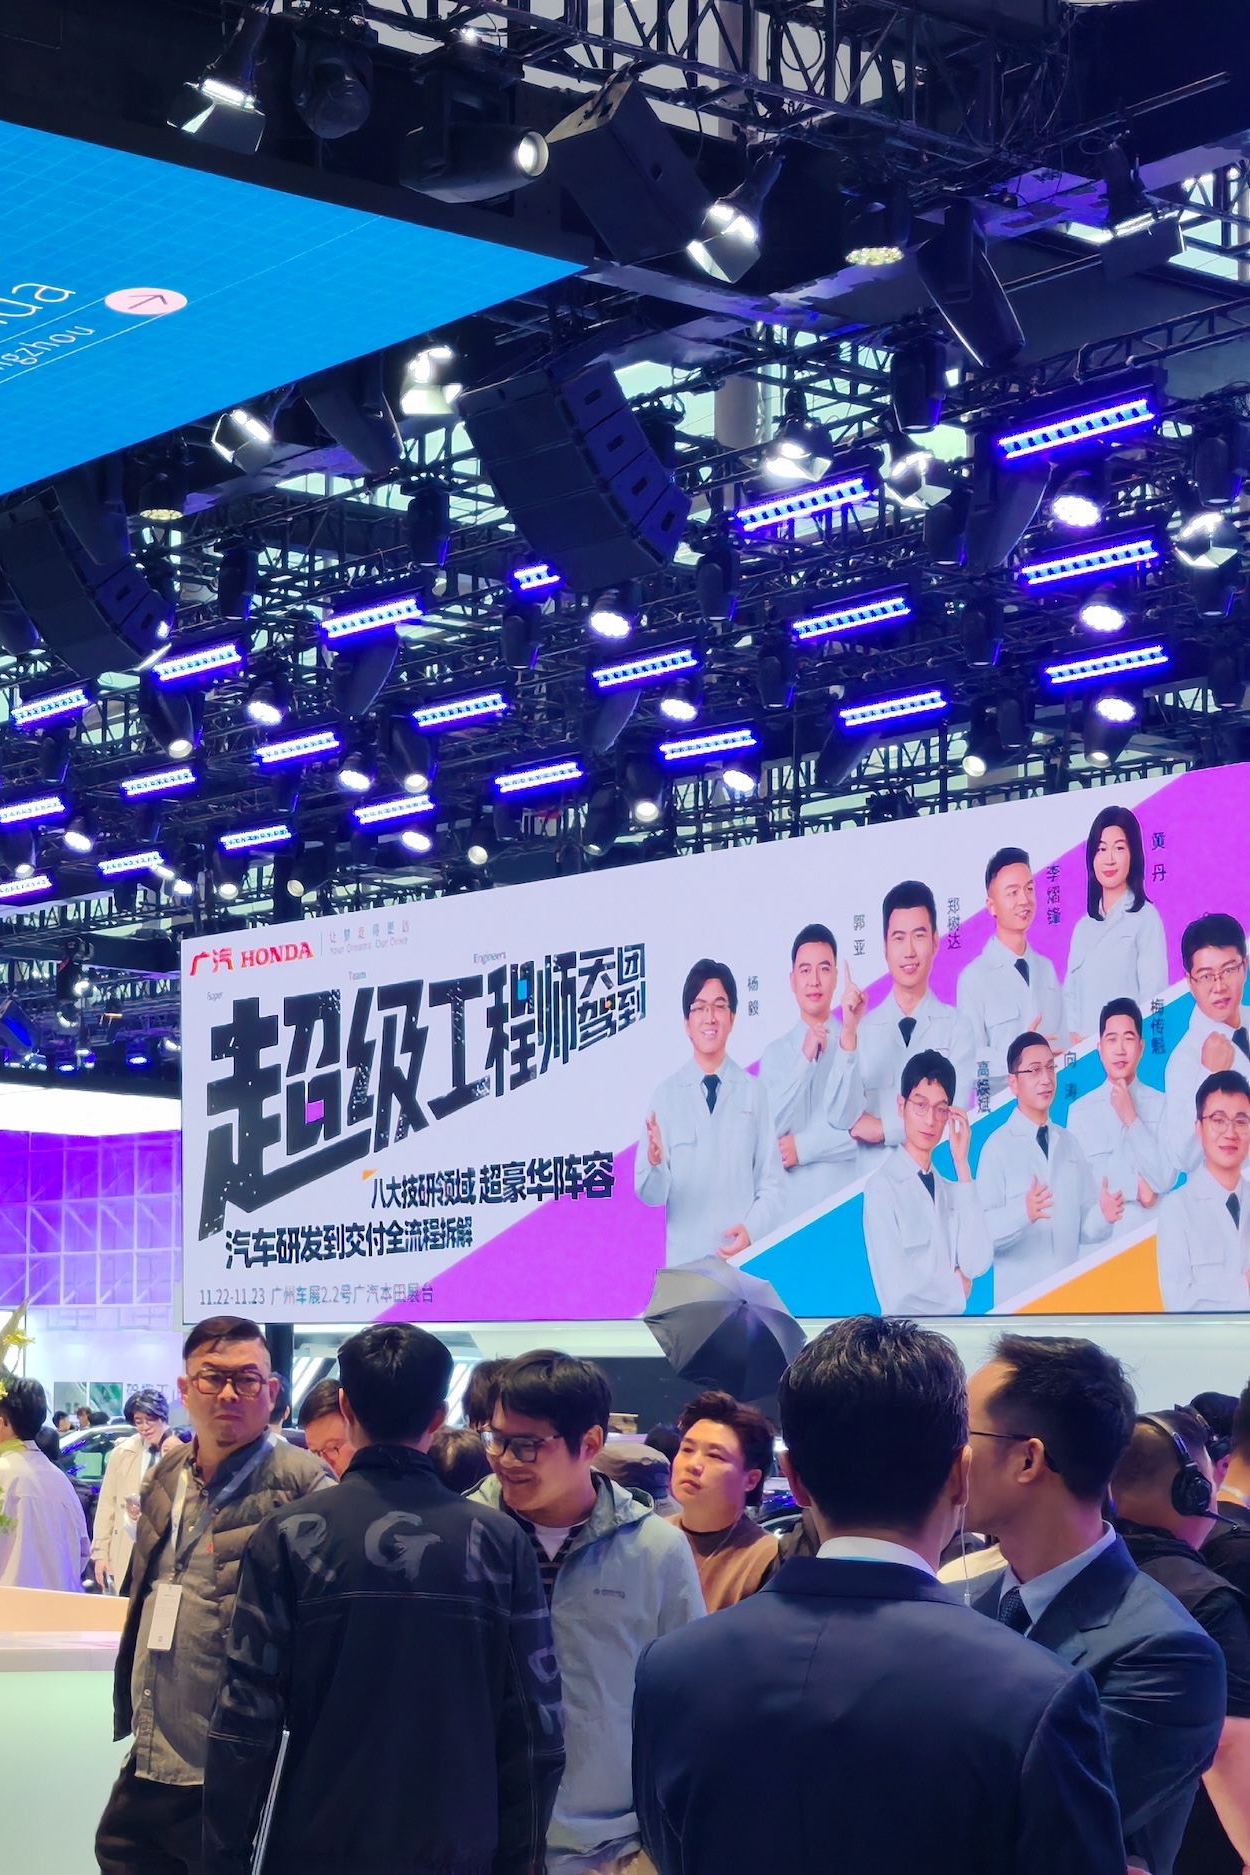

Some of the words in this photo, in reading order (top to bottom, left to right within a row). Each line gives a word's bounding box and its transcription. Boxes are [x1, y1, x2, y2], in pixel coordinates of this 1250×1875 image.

[189, 947, 234, 977] 广汽
[240, 941, 315, 968] HONDA
[348, 970, 367, 980] Team
[473, 950, 508, 964] Engineers
[579, 942, 646, 996] 天团
[206, 990, 224, 1002] Super
[577, 981, 647, 1051] 驾到
[198, 950, 578, 1241] 超级工程师
[370, 1167, 477, 1209] 八大技研领域
[478, 1151, 616, 1204] 超豪华阵容
[224, 1216, 474, 1270] 汽车研发到交付全流程拆解
[199, 1287, 266, 1306] 11.22-11.23
[270, 1282, 434, 1305] 广州车展2.2号广汽本田展台
